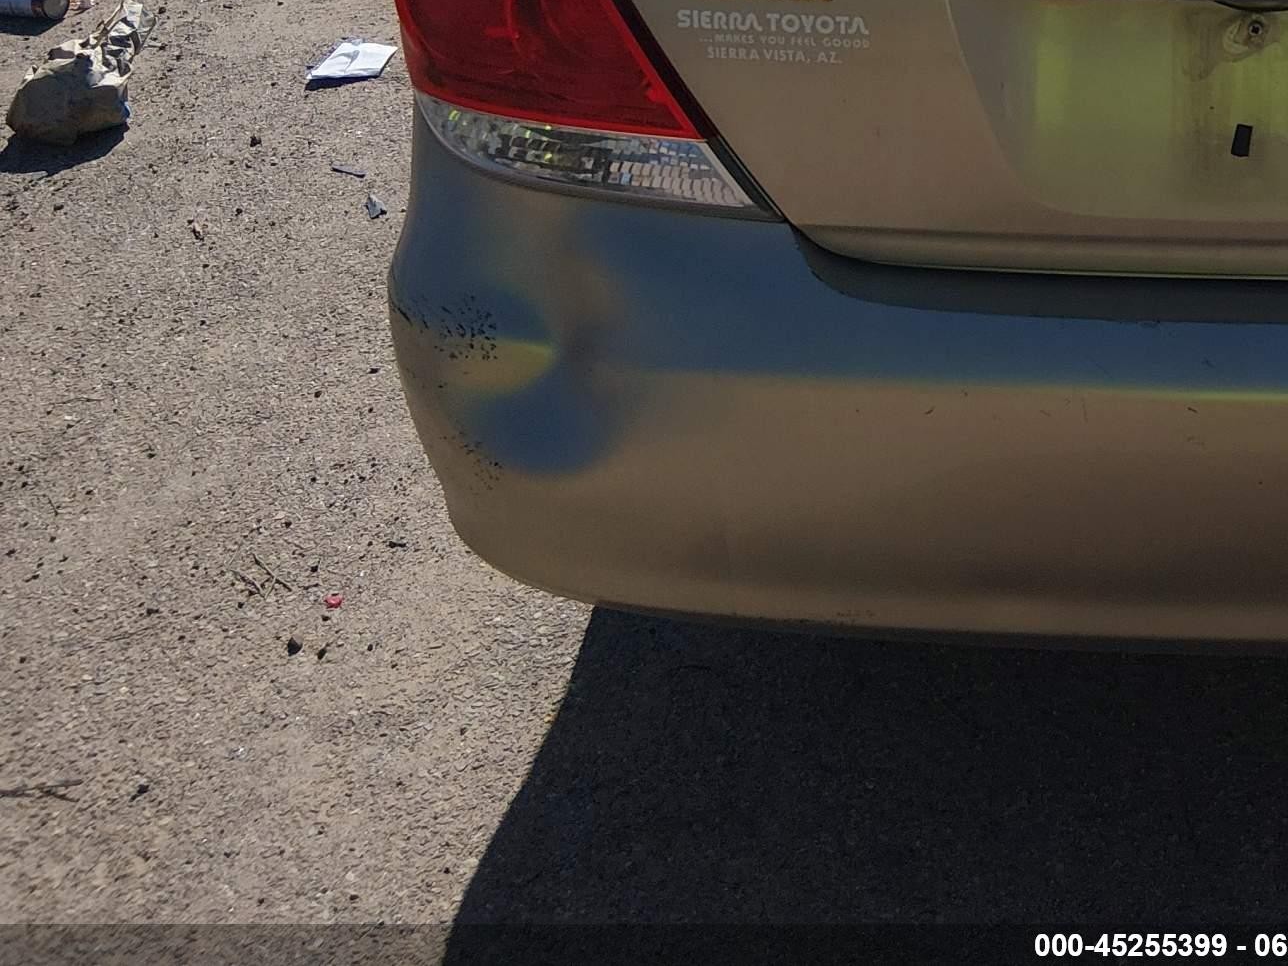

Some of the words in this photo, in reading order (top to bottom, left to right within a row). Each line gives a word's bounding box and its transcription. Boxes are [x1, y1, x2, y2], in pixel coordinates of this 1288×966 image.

[676, 9, 763, 32] SIERRA
[766, 13, 870, 36] TOYOTA
[759, 35, 785, 45] YOU
[790, 36, 817, 47] FEEL
[707, 46, 761, 60] SIERRA
[764, 48, 812, 64] VISTA,
